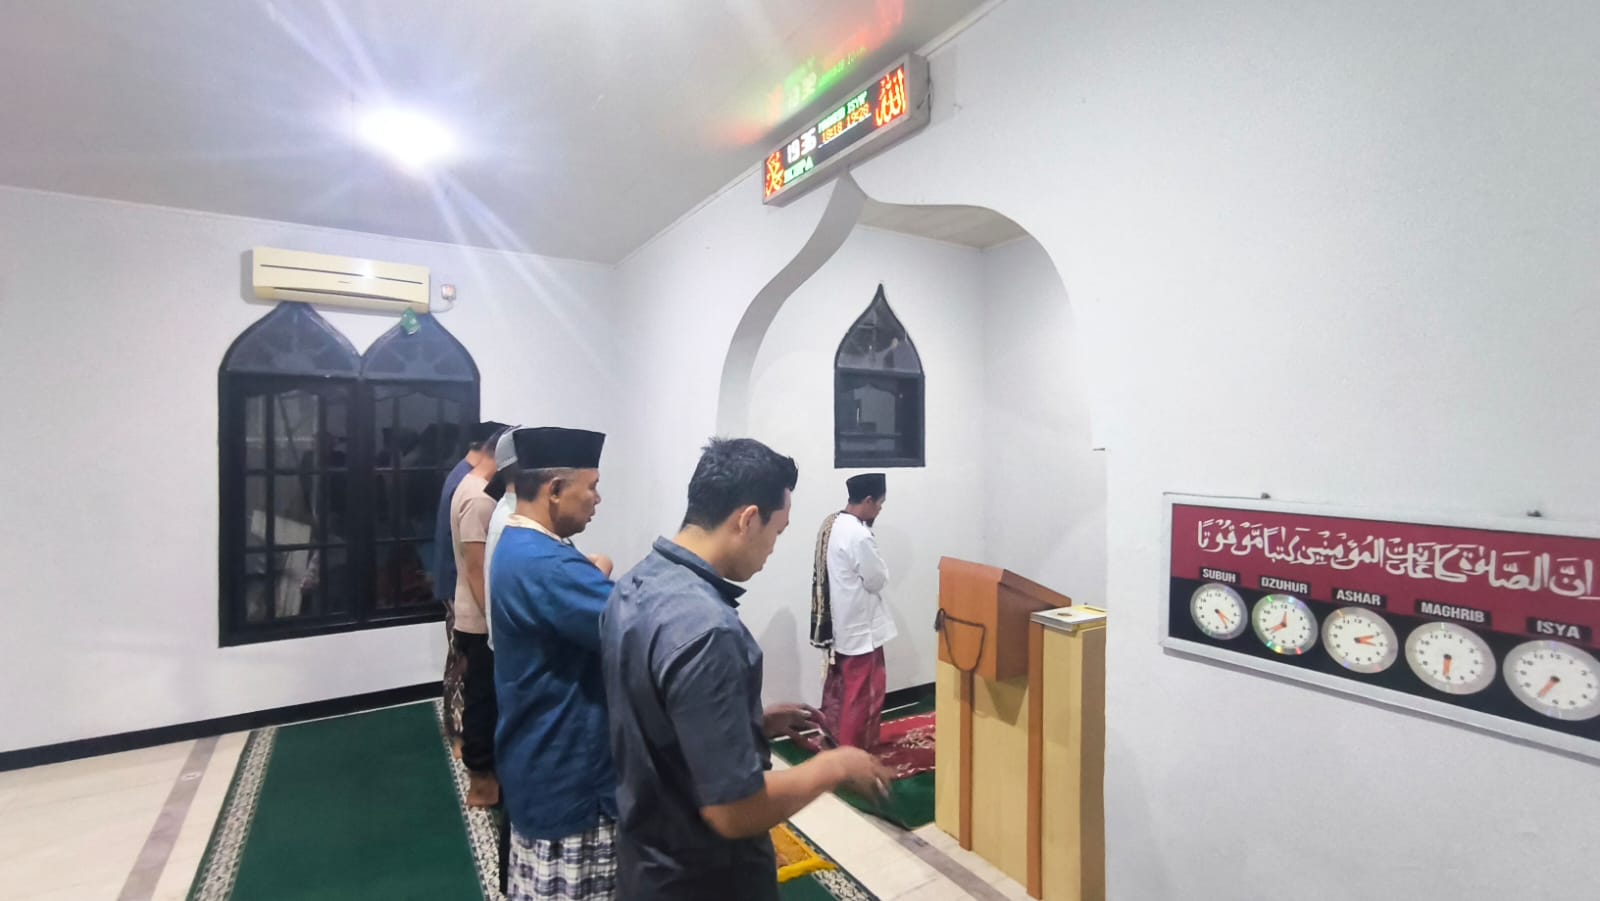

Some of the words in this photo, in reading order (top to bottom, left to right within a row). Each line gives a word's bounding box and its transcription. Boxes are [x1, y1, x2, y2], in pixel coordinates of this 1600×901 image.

[1202, 568, 1236, 583] SUBUH
[1261, 576, 1308, 594] DZUHUR
[1336, 589, 1381, 606] ASHAR
[1421, 601, 1485, 623] MAGHRIB
[1536, 620, 1581, 639] ISYA
